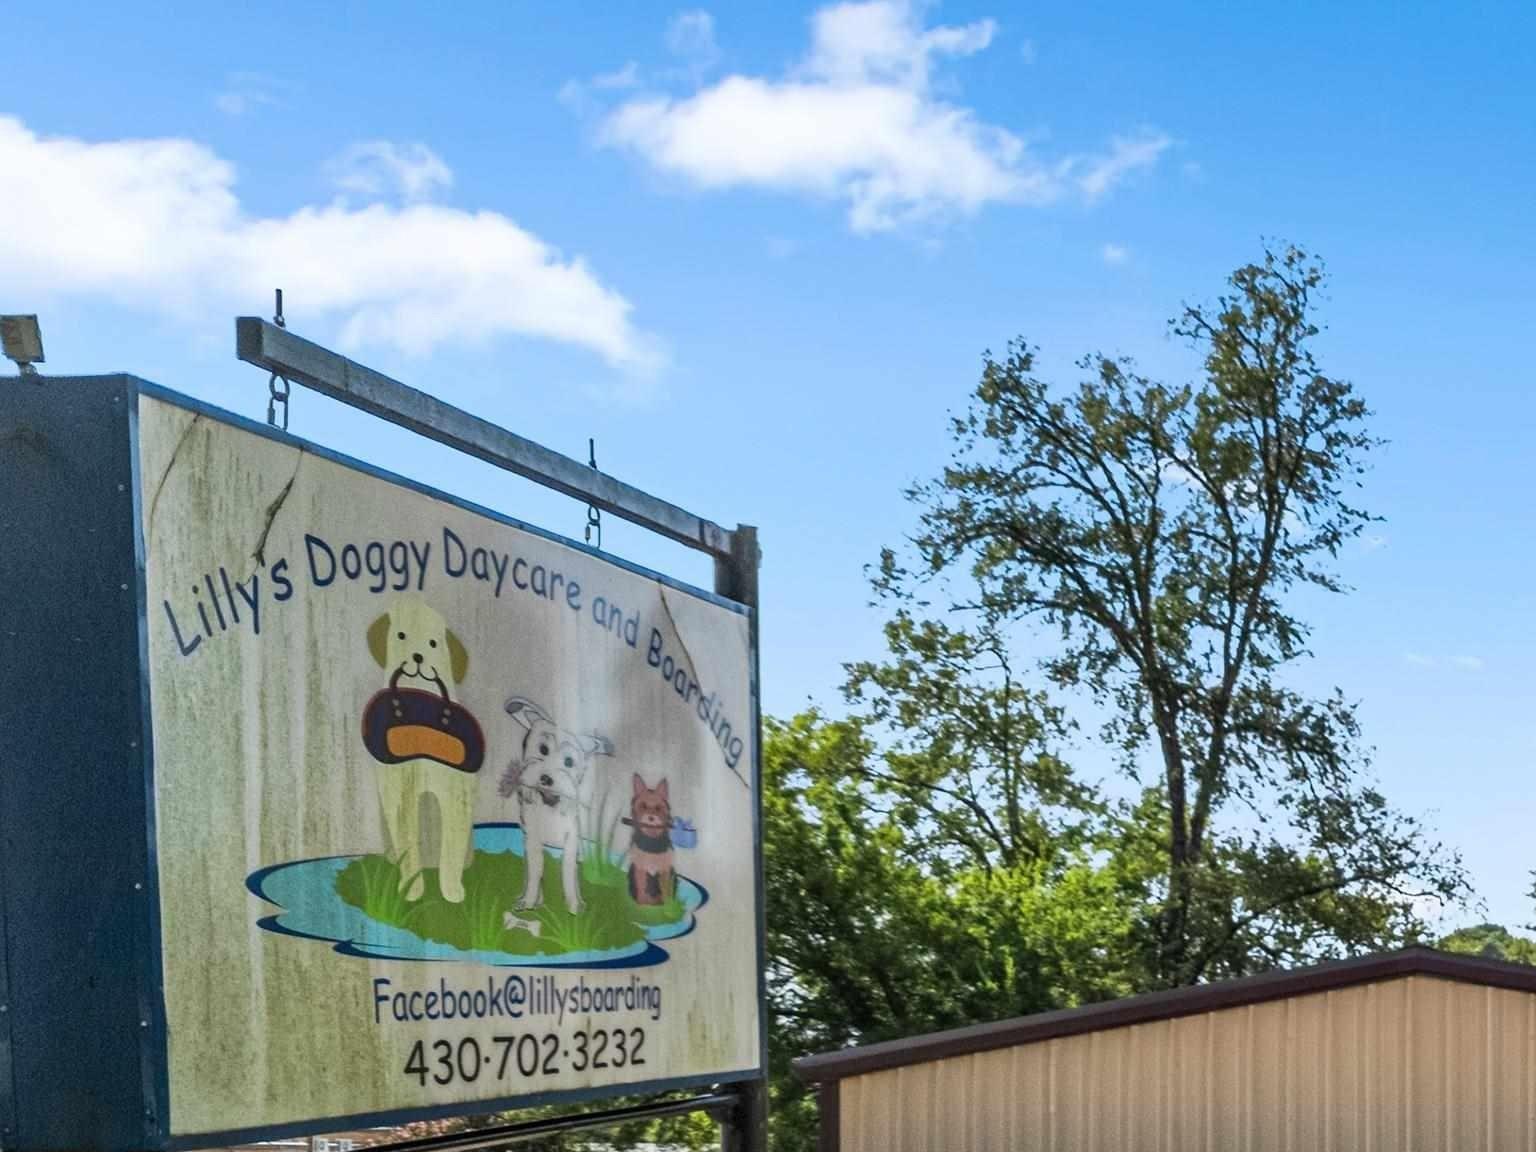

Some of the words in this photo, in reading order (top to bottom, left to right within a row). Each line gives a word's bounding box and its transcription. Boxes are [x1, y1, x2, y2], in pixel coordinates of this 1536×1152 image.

[164, 558, 294, 657] Lilly's
[304, 532, 431, 593] Doggy
[442, 526, 582, 611] Daycare
[592, 594, 641, 650] and
[647, 626, 744, 768] Boarding
[372, 975, 662, 1025] Facebook@lillysboarding
